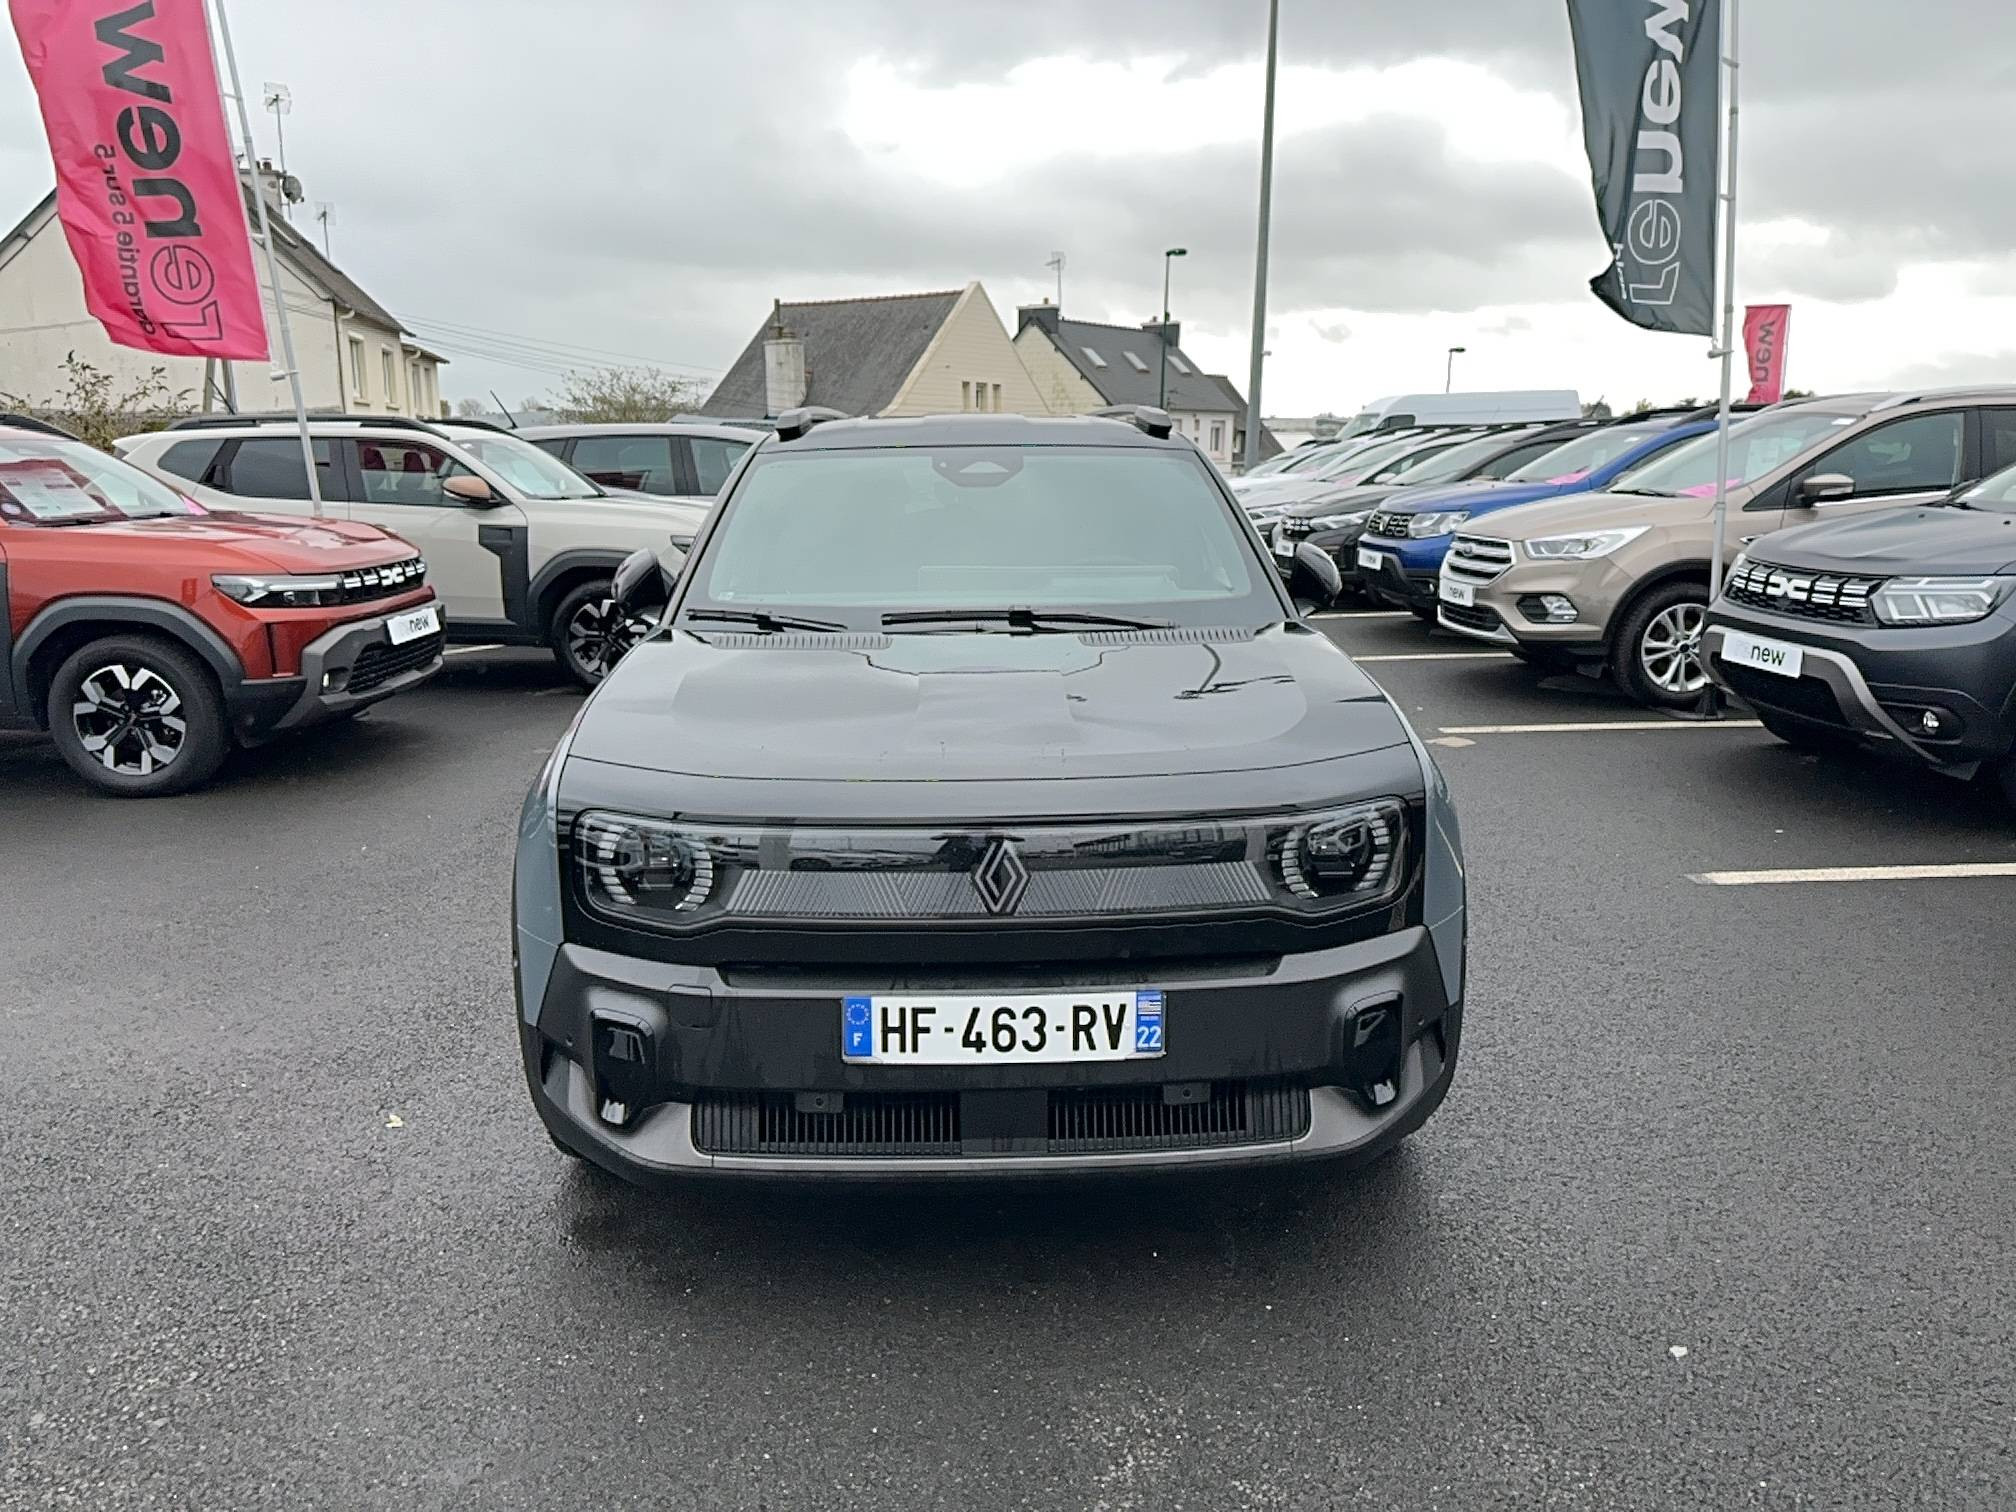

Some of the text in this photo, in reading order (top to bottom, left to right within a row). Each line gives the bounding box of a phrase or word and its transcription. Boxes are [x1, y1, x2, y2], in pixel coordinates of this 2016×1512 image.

[853, 1003, 1162, 1054] F HF-463-RV 22
